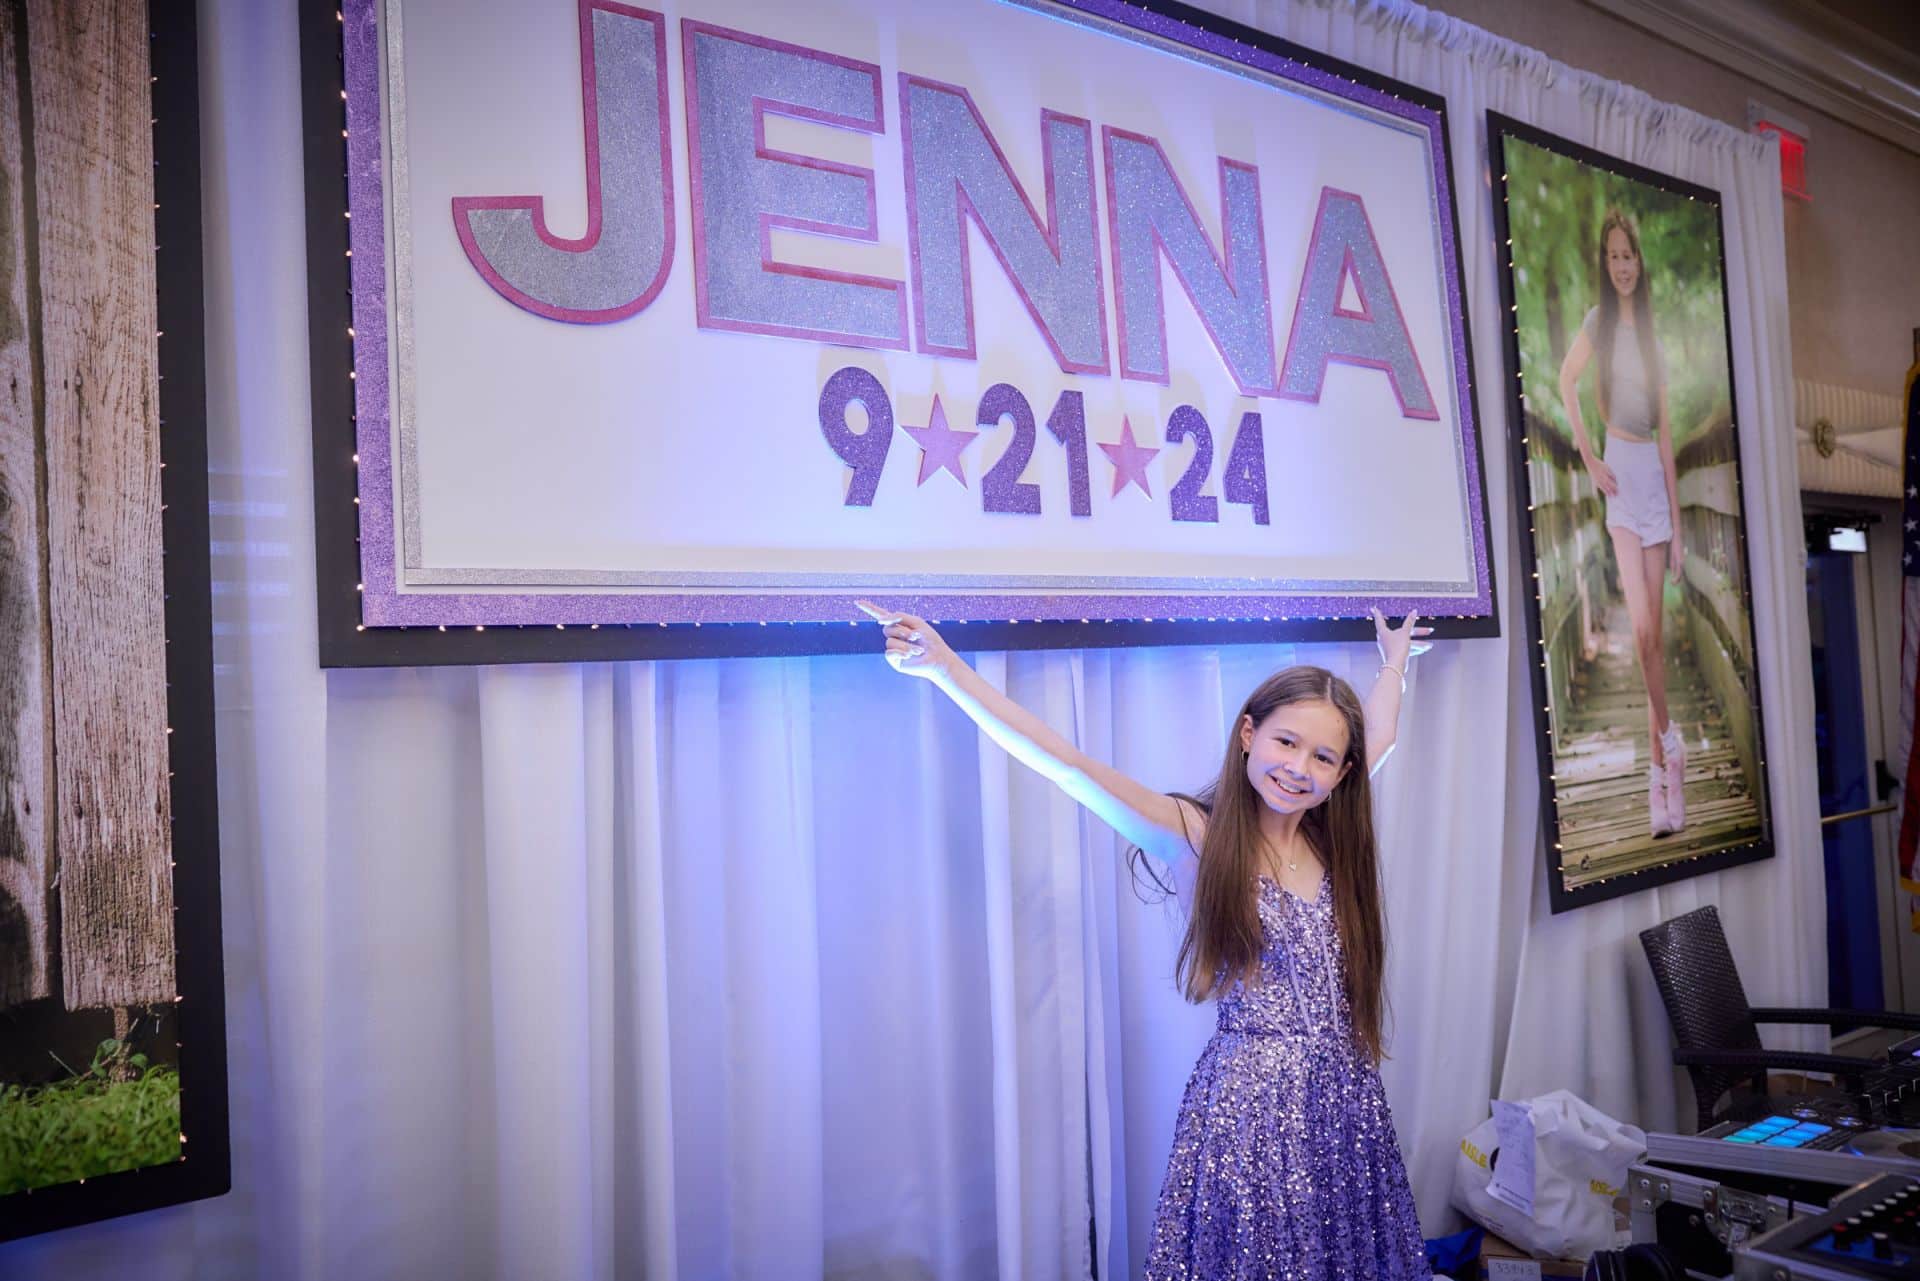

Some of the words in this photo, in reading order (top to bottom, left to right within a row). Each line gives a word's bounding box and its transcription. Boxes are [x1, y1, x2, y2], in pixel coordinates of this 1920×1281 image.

[452, 0, 1440, 421] JENNA
[818, 366, 894, 507] 9
[976, 383, 1092, 517] 21
[1166, 404, 1271, 526] 24
